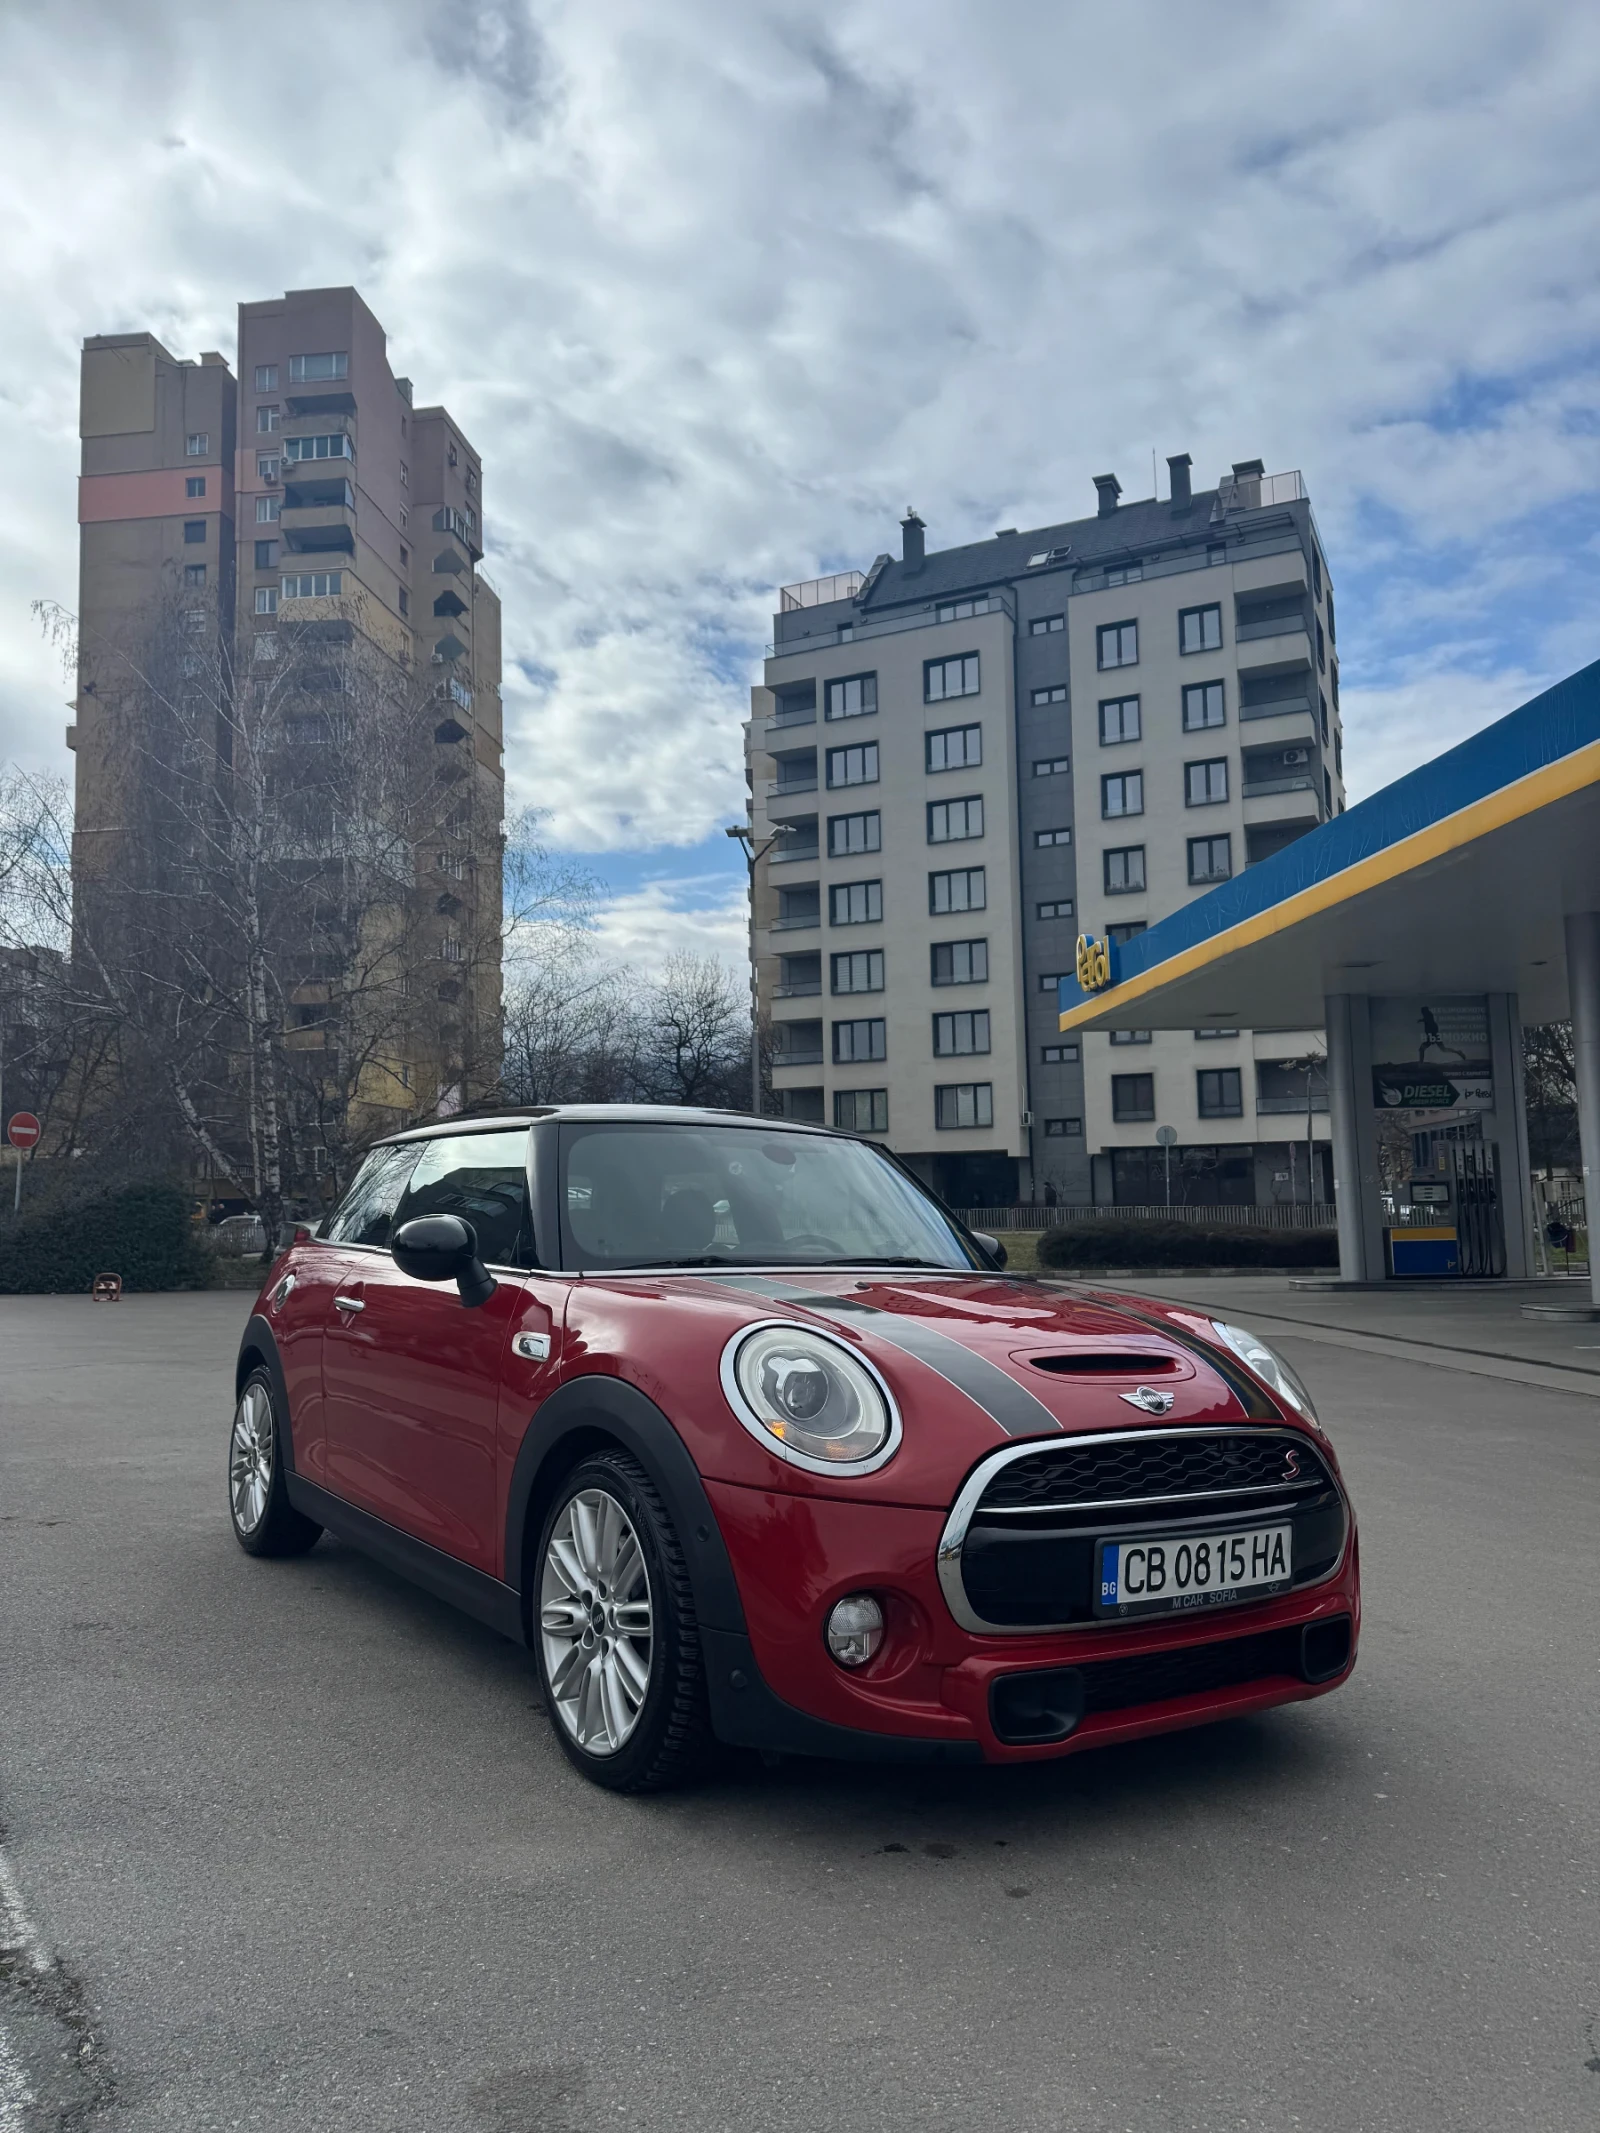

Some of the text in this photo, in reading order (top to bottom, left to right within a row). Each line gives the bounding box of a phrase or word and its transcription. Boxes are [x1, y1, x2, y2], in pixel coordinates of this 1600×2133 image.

[1420, 1032, 1487, 1042] ВЪЗМОЖНО
[1404, 1085, 1451, 1098] DIESEL
[1142, 1394, 1163, 1403] MINI
[1281, 1449, 1300, 1481] S
[1175, 1538, 1246, 1588] 0815
[1101, 1581, 1117, 1596] BG
[1172, 1589, 1238, 1609] M CAR SOFIA
